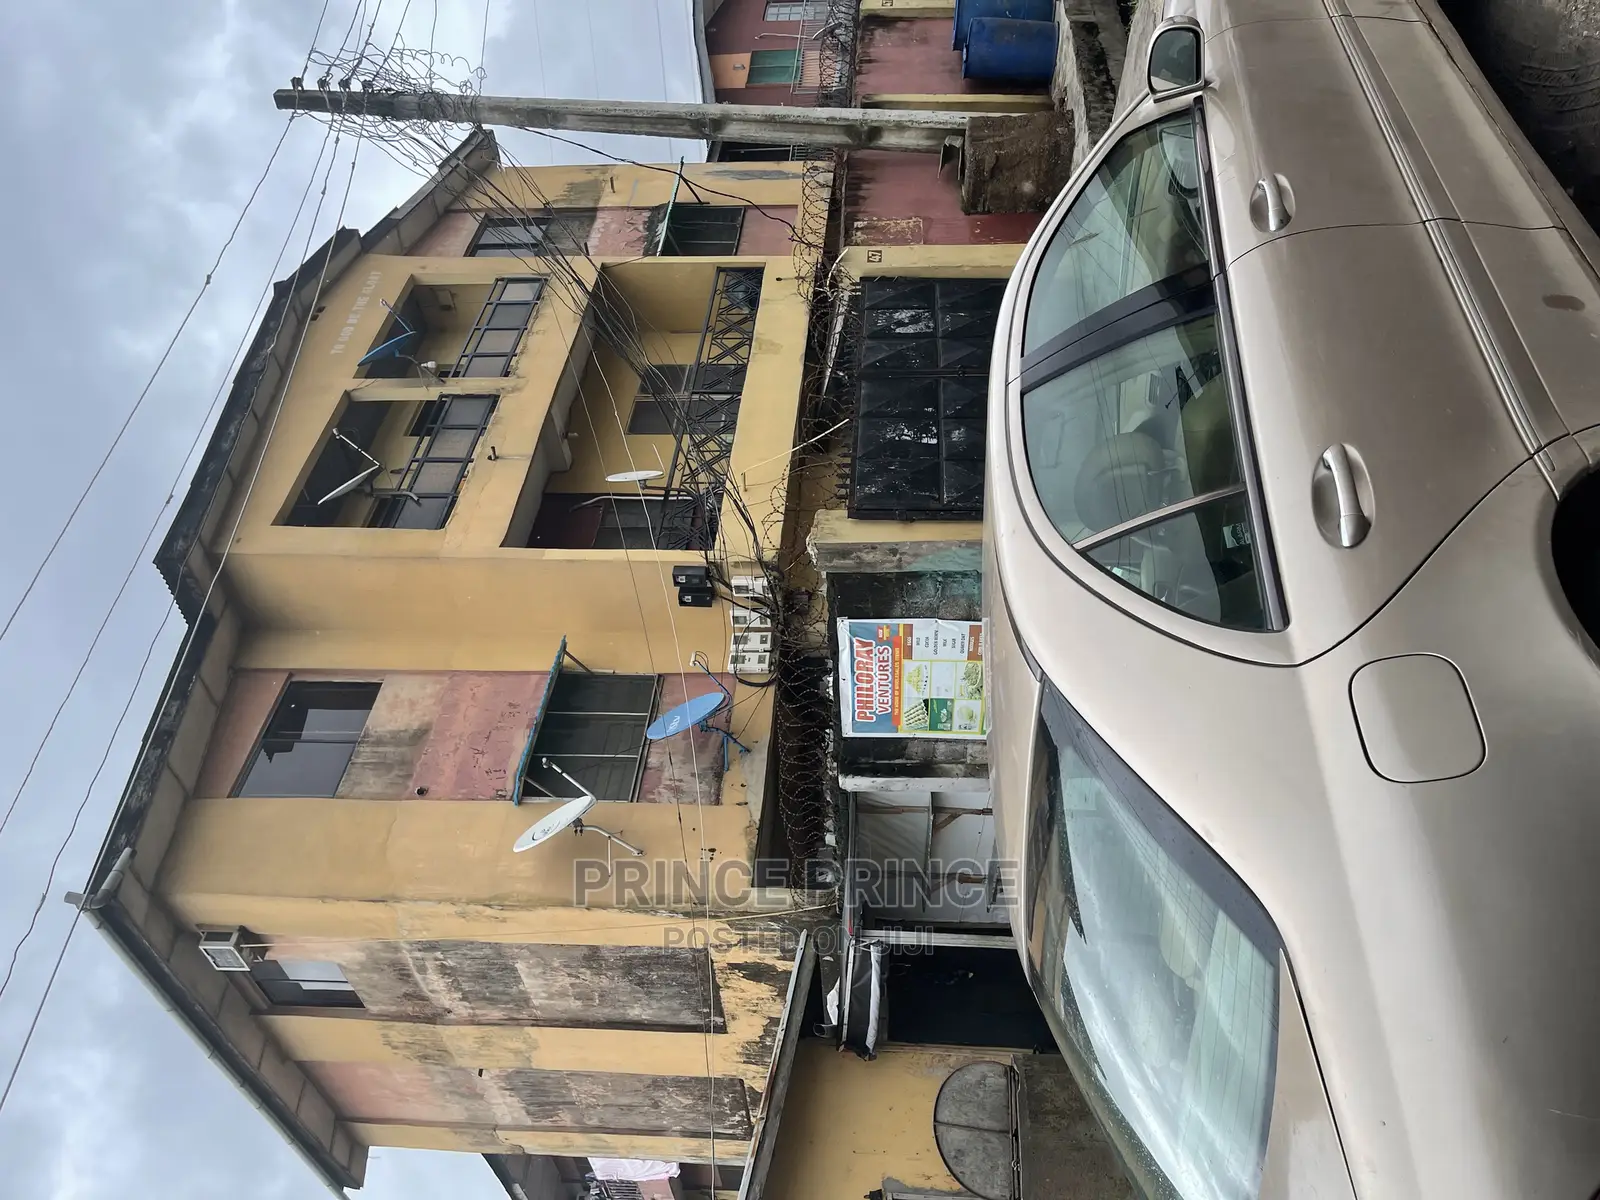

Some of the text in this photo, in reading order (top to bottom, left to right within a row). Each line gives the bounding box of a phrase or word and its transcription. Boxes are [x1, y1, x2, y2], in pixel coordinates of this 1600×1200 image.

[868, 251, 882, 262] 47
[855, 638, 875, 721] PHILORAY
[878, 647, 890, 714] VENTURES
